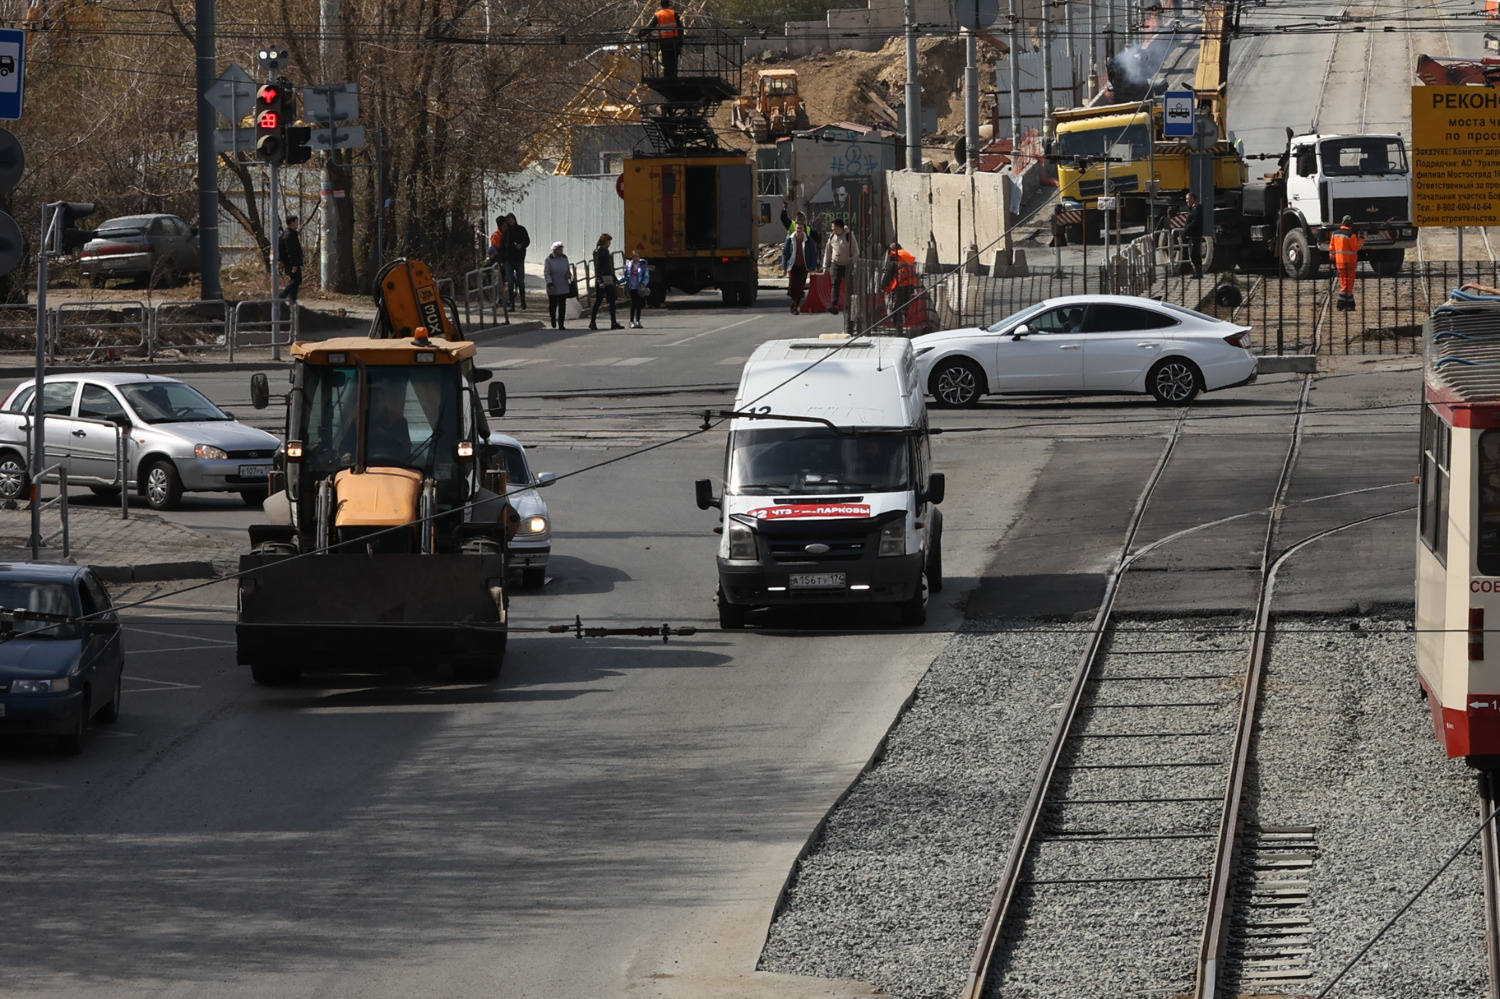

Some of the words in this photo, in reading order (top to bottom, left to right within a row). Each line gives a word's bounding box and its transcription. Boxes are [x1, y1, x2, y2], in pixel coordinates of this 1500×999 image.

[261, 113, 275, 128] 28
[1448, 118, 1485, 127] моста
[1445, 132, 1460, 141] по
[1415, 148, 1451, 156] Заказчик:
[1415, 160, 1459, 168] Подрядчик:
[1416, 170, 1446, 179] филиал
[1447, 171, 1492, 179] Мостоотряд
[1416, 181, 1474, 190] Ответственный
[1416, 192, 1457, 200] Начальник
[1457, 193, 1487, 201] участка
[1416, 203, 1435, 211] Тел.:
[1416, 214, 1440, 223] Сроки
[1441, 215, 1497, 224] строительства:
